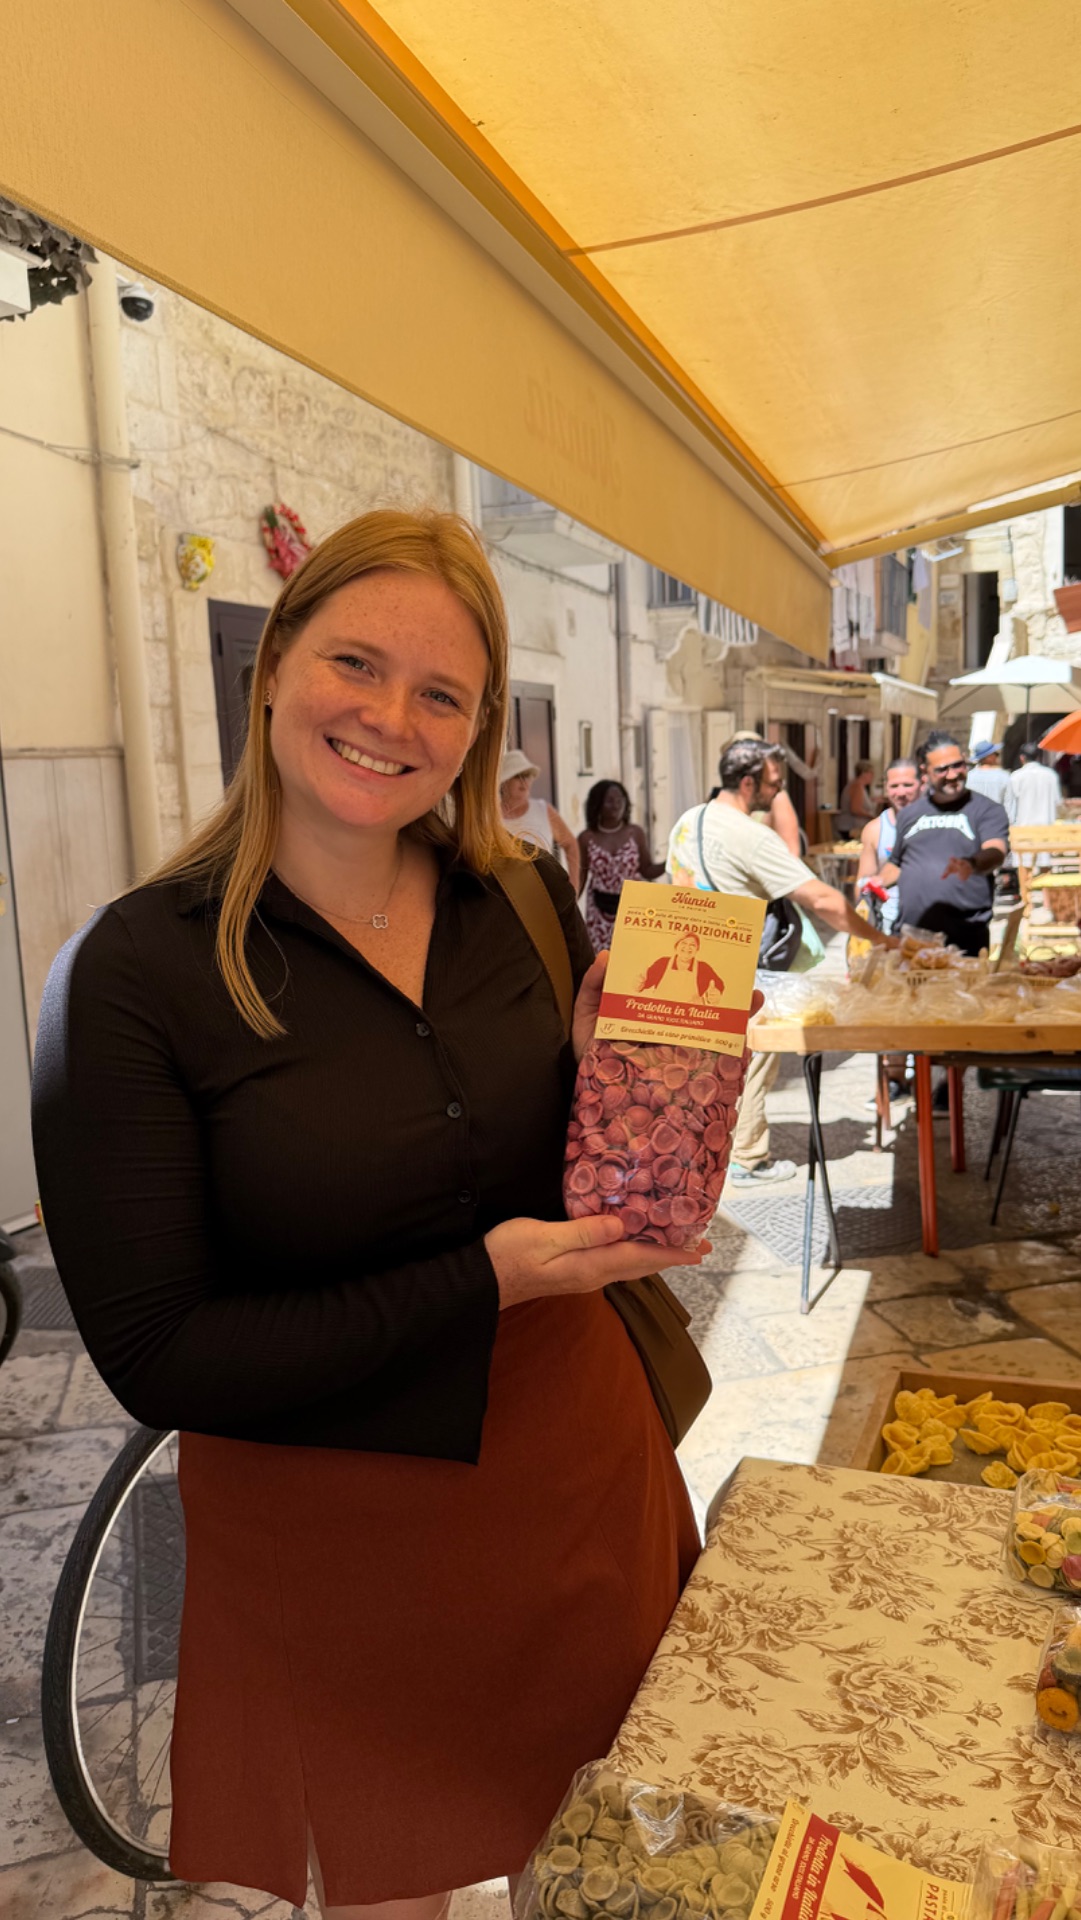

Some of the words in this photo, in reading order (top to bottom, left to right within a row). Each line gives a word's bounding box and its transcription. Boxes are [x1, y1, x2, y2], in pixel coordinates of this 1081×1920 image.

[671, 891, 717, 909] Nunzia
[624, 916, 663, 929] PASTA
[668, 921, 753, 944] TRADIZIONALE
[625, 998, 673, 1014] Prodotta
[674, 1005, 686, 1016] in
[688, 1006, 721, 1020] Italia
[810, 1834, 833, 1875] Prodotta
[806, 1873, 821, 1887] in
[764, 1898, 774, 1915] 500
[923, 1882, 940, 1920] PASTA
